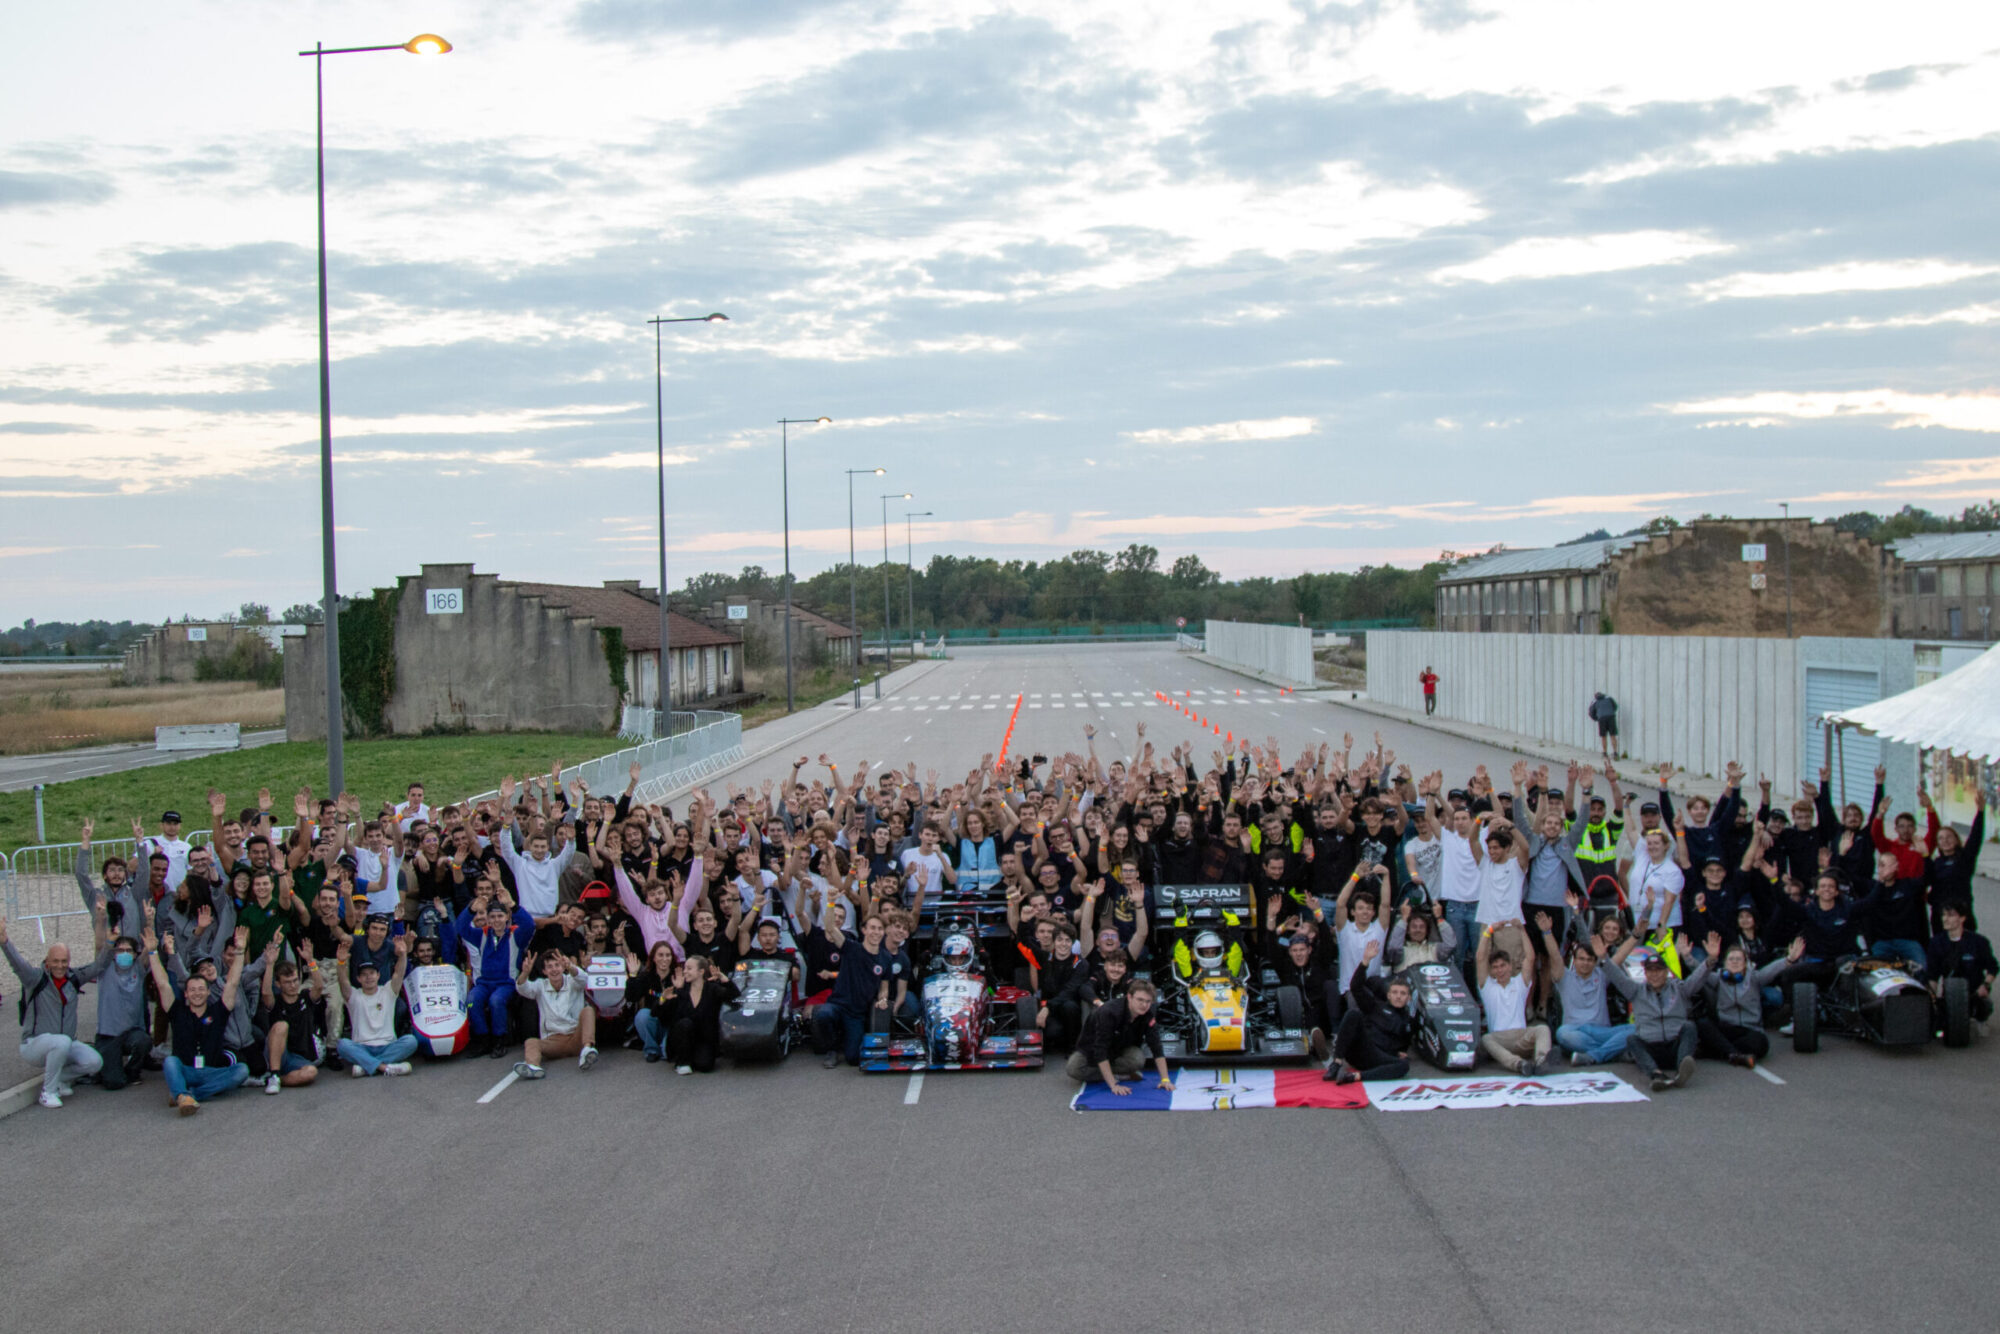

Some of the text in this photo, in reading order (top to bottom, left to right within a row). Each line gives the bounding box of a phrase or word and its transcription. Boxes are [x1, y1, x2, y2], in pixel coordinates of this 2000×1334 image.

[432, 593, 457, 610] 166
[1180, 887, 1241, 899] SAFRAN
[595, 976, 619, 987] 81
[746, 988, 778, 999] 23
[426, 995, 452, 1007] 58
[1388, 1081, 1552, 1097] INSA
